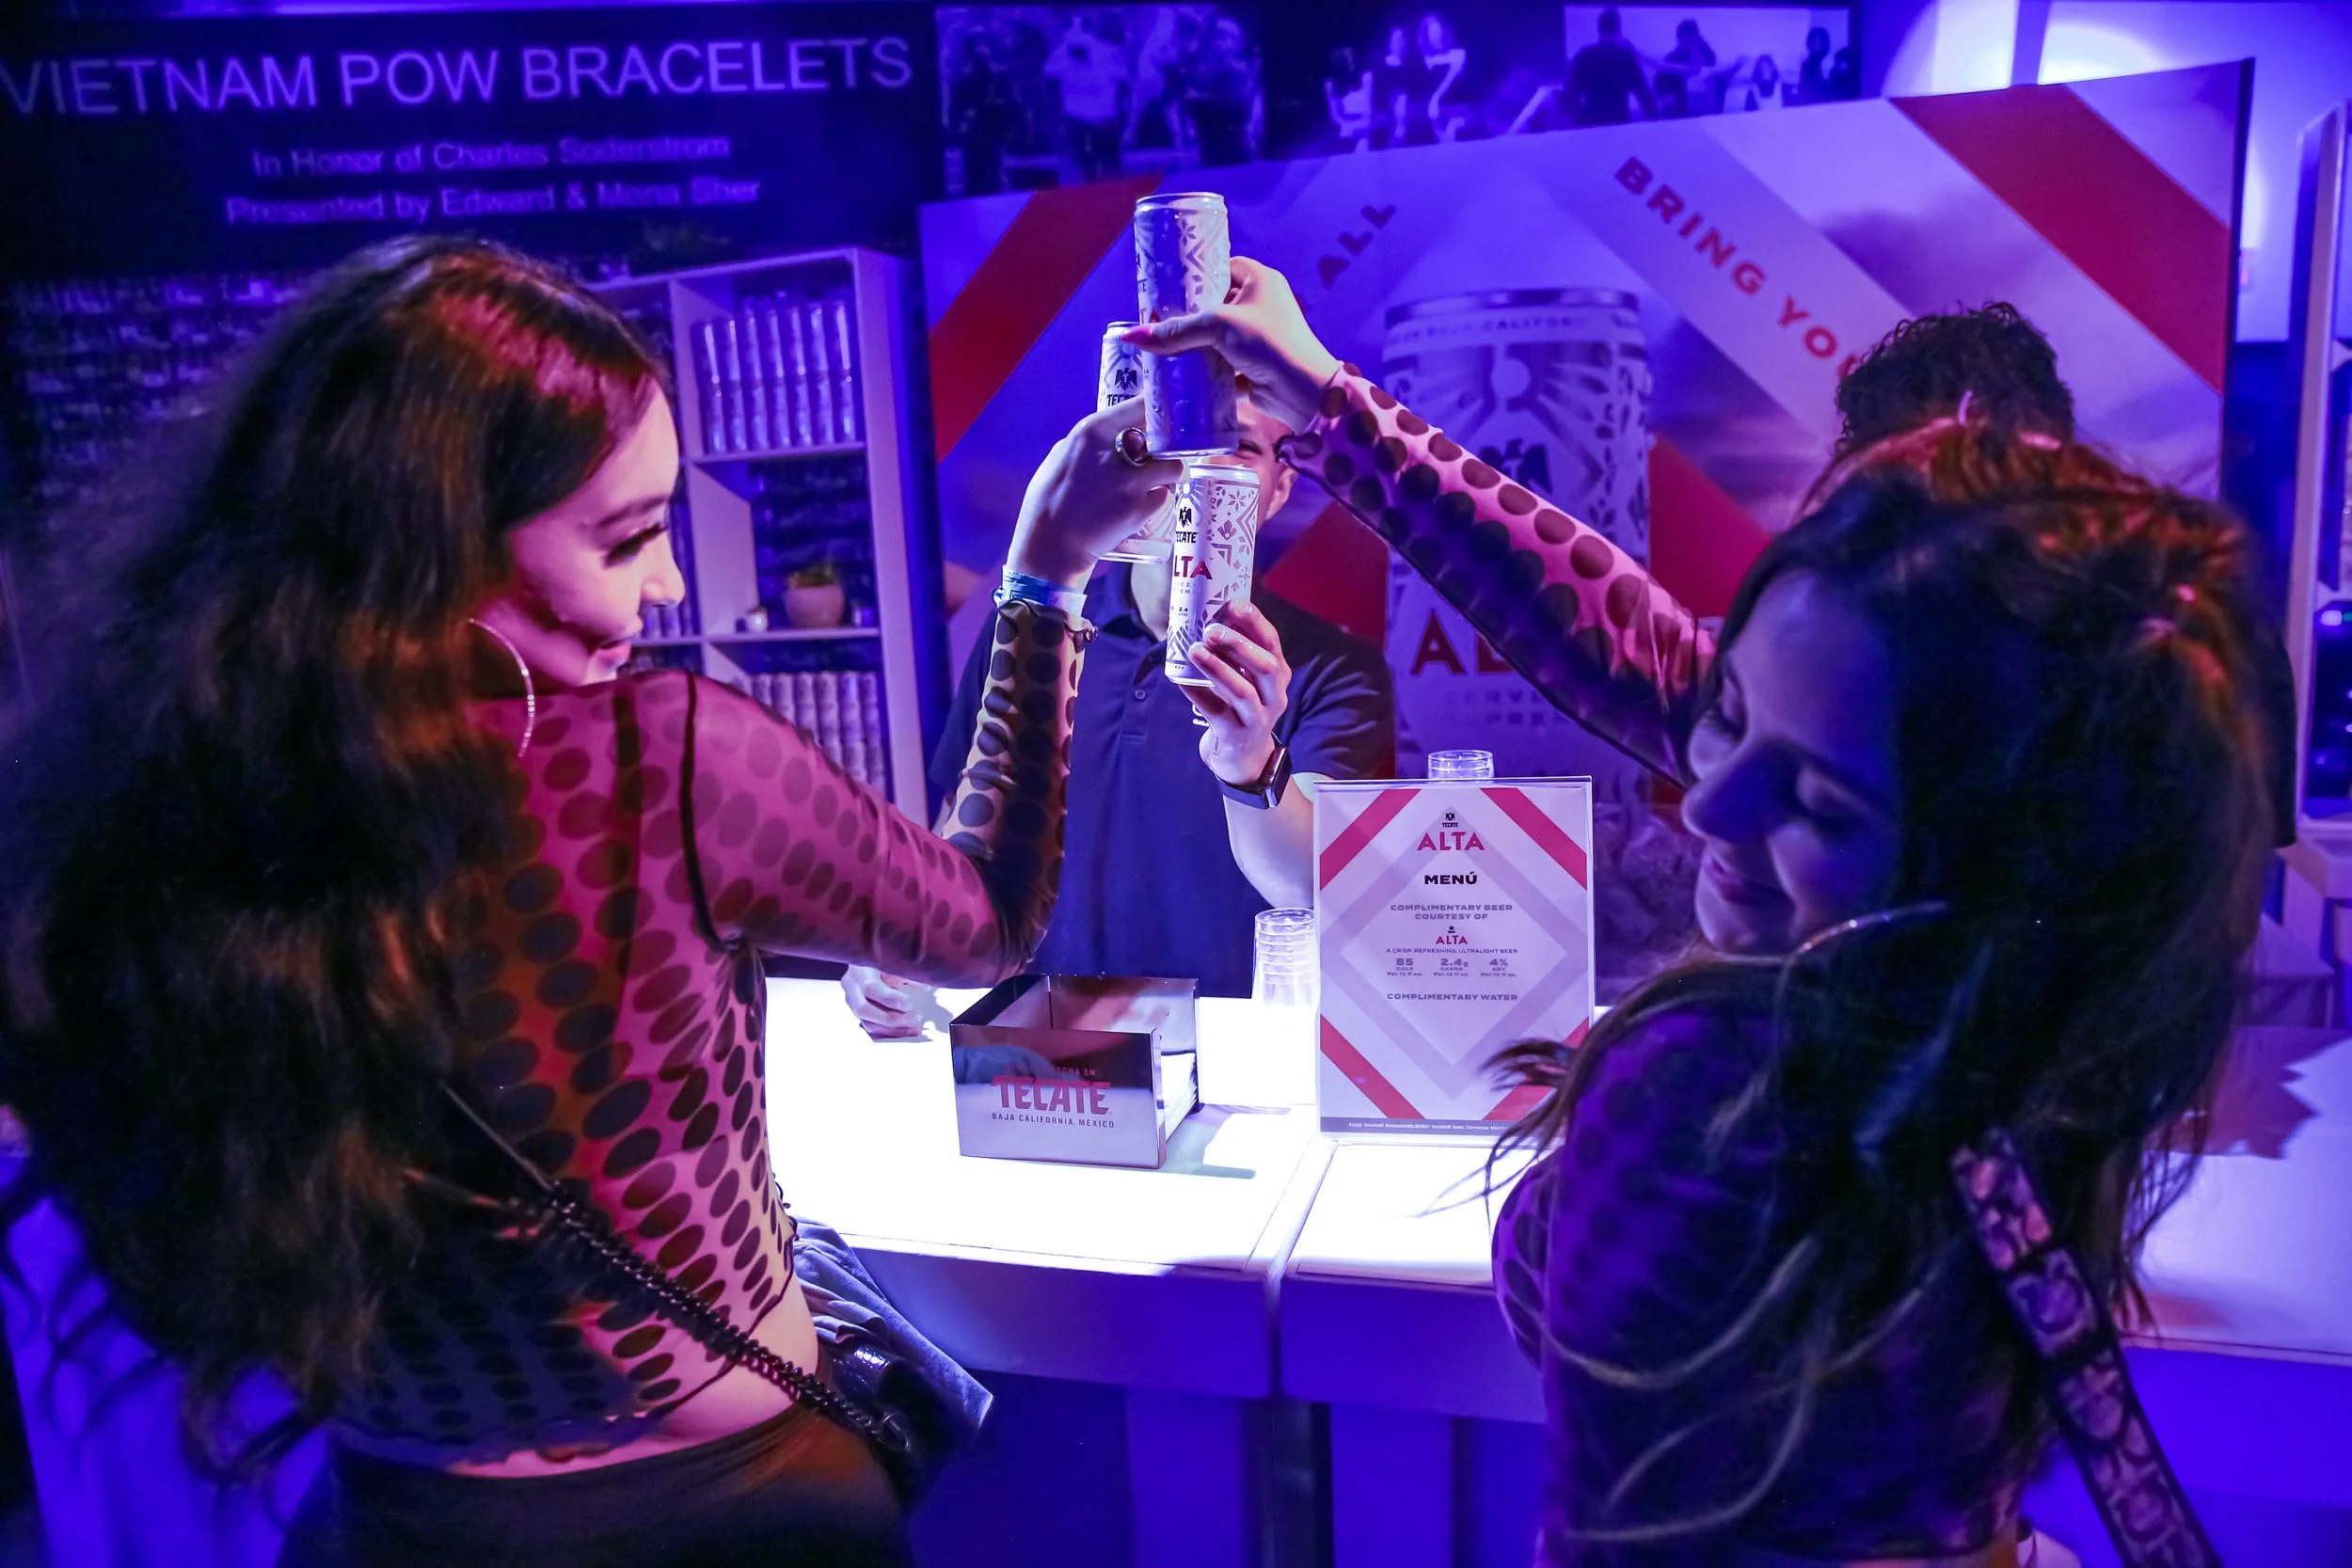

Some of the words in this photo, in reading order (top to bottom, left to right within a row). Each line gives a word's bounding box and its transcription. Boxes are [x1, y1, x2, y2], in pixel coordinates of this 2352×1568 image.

[0, 54, 318, 114] VIETNAM
[340, 49, 500, 106] POW
[522, 36, 914, 102] BRACELETS
[253, 149, 282, 177] In
[290, 147, 385, 177] Honor
[394, 143, 422, 172] of
[226, 193, 385, 225] Presented
[394, 192, 431, 225] by
[439, 184, 555, 216] Edward
[1614, 155, 1767, 296] BRING
[1318, 204, 1397, 291] ALL
[1173, 555, 1214, 580] LTA
[1416, 831, 1486, 851] ALTA
[1423, 871, 1478, 885] MENÚ
[1435, 935, 1469, 945] ALTA
[1395, 958, 1414, 966] 85
[1440, 958, 1469, 968] 2.4g
[1488, 958, 1509, 967] 4%
[1084, 1068, 1096, 1076] EN
[990, 1074, 1112, 1116] TECATE
[992, 1112, 1015, 1121] BAJA
[1018, 1114, 1075, 1127] CALIFORNIA,
[1078, 1118, 1115, 1129] MEXICO
